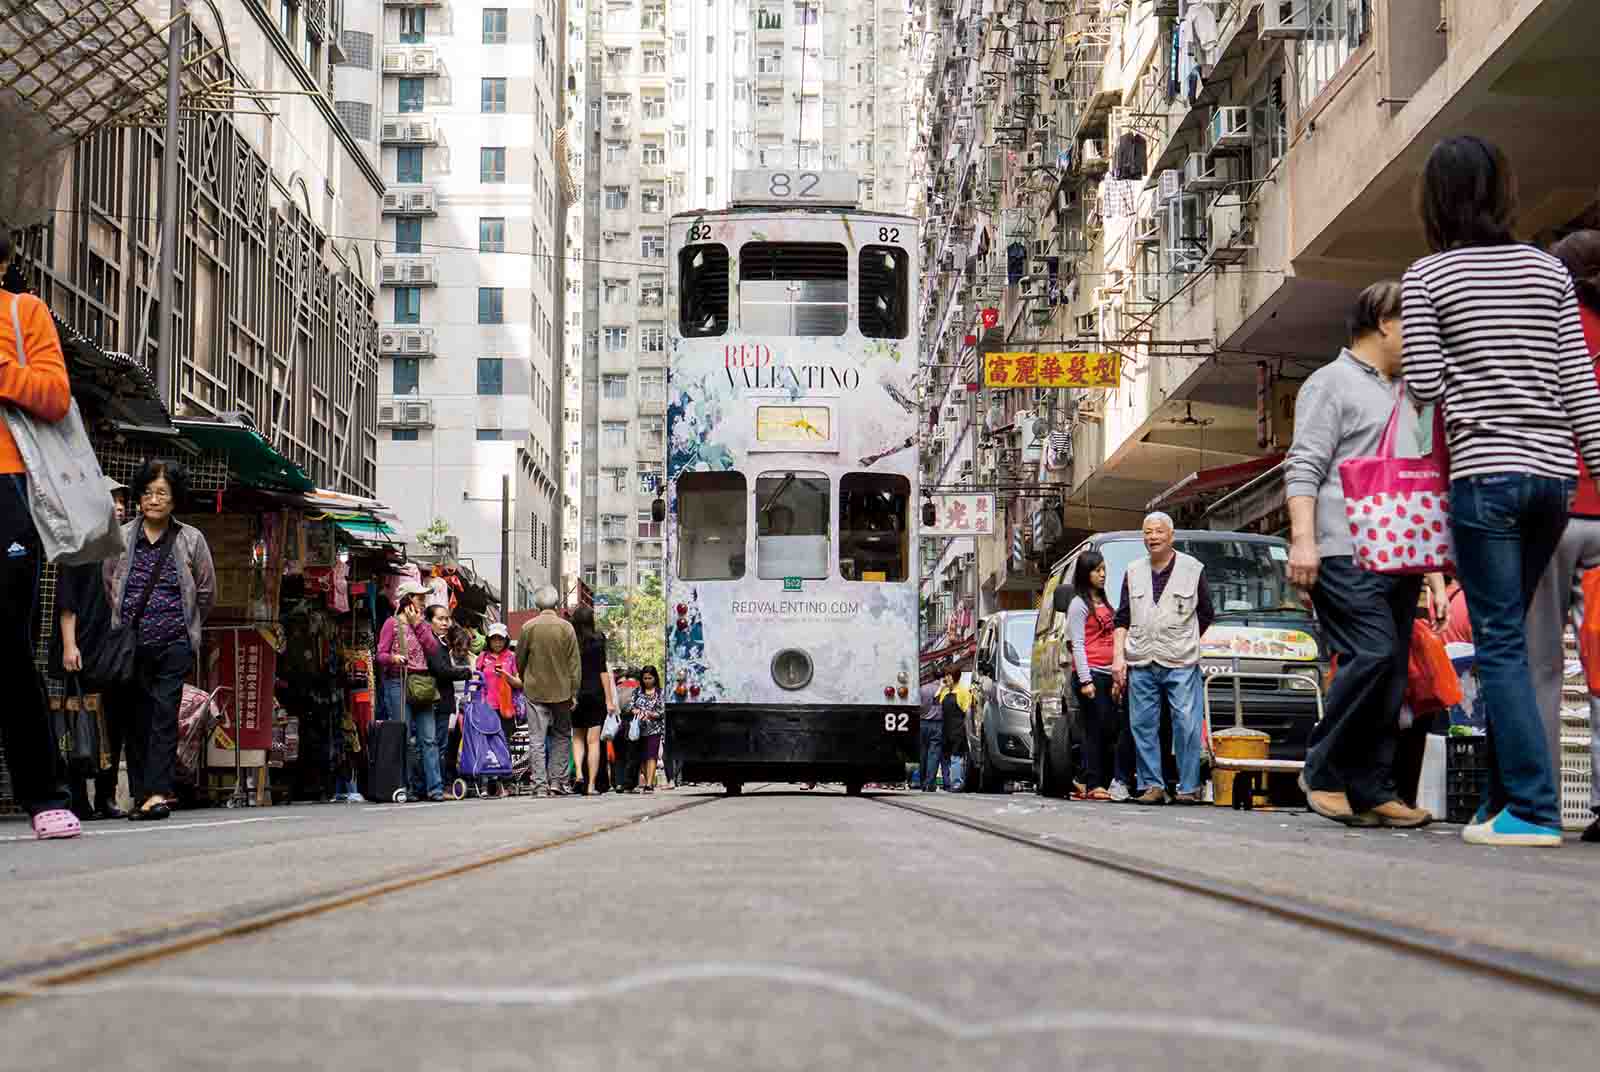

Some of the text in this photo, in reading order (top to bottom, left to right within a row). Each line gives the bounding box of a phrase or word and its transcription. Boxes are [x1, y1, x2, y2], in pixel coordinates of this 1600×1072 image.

[769, 172, 820, 198] 82
[690, 225, 712, 240] 82
[879, 228, 900, 243] 82
[725, 345, 770, 368] RED
[725, 366, 860, 389] VALENTINO
[989, 355, 1117, 385] 富麗華髮型
[732, 600, 858, 614] REDVALENTINO.COM
[884, 713, 909, 732] 82
